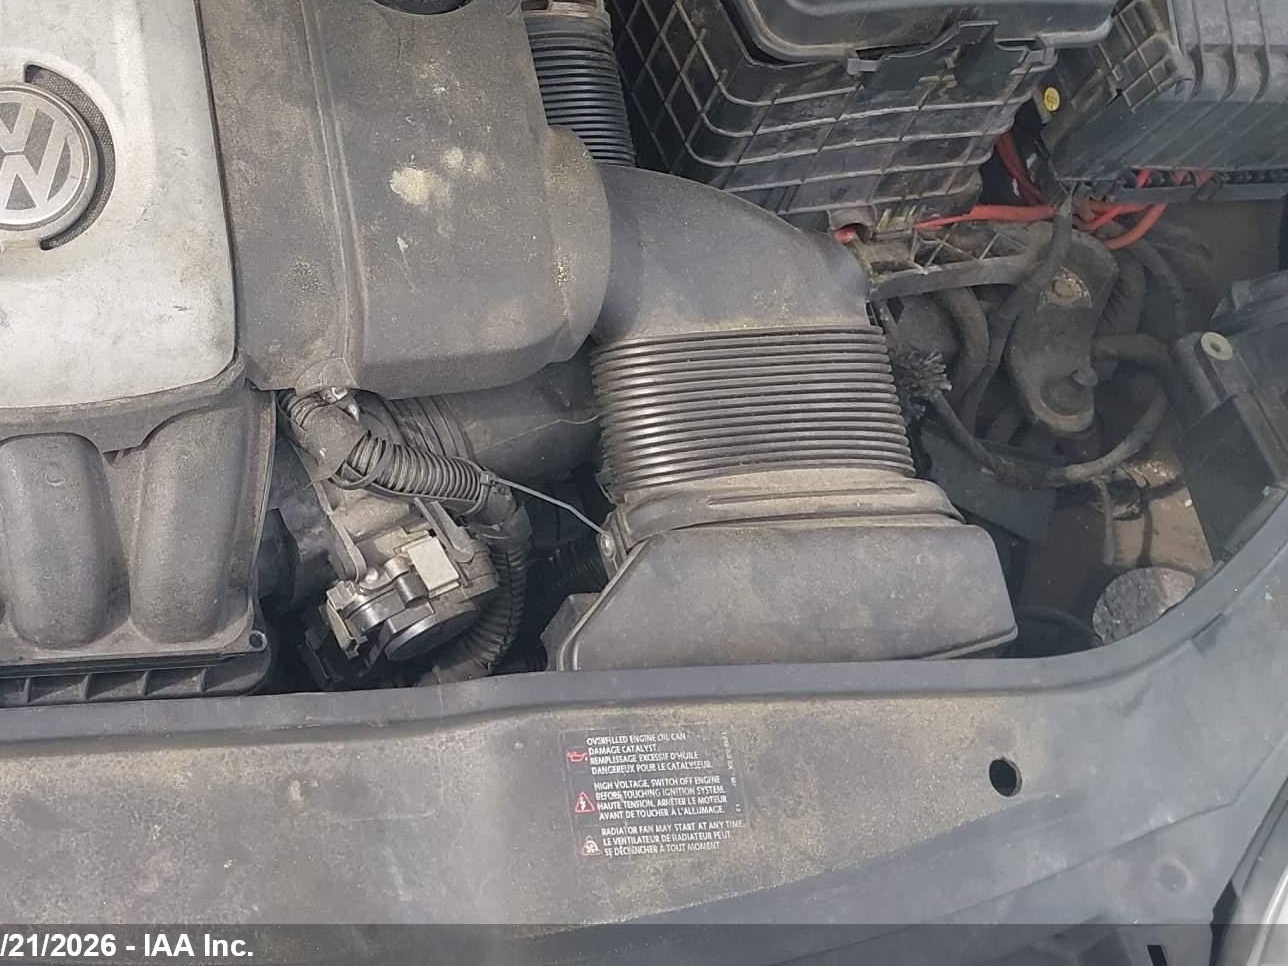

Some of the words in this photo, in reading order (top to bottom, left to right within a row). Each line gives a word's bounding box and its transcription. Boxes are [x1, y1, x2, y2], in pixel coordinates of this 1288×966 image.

[586, 735, 629, 746] OVERFILLED
[629, 734, 656, 744] ENGINE
[657, 733, 670, 742] OIL
[670, 732, 686, 741] CAN
[587, 745, 621, 755] DAMAGE
[590, 754, 637, 765] REMPLISSAGE
[638, 752, 669, 763] EXCESSIF
[670, 751, 699, 761] D'HUILE
[591, 763, 636, 775] DANGEREUX
[636, 762, 657, 773] POUR
[657, 762, 666, 771] LE
[593, 781, 613, 790] HIGH
[650, 777, 679, 787] SWITCH
[679, 777, 692, 786] OFF
[694, 775, 721, 785] ENGINE
[595, 791, 622, 801] BEFORE
[622, 788, 661, 800] TOUCHING
[661, 786, 696, 797] IGNITION
[597, 801, 622, 811] HAUTE
[687, 796, 697, 805] LE
[697, 795, 728, 805] MOTEUR
[599, 810, 624, 821] AVANT
[625, 810, 636, 819] DE
[636, 808, 669, 819] TOUCHER
[601, 825, 638, 836] RADIATOR
[638, 825, 654, 834] FAN
[655, 824, 672, 833] MAY
[673, 822, 696, 832] START
[698, 821, 708, 831] AT
[708, 820, 724, 830] ANY
[602, 837, 612, 846] LE
[612, 835, 660, 846] VENTILATEUR
[661, 833, 671, 843] DE
[671, 831, 712, 843] RADIATEUR
[713, 830, 731, 840] PEUT
[604, 847, 613, 857] SE
[666, 843, 686, 852] TOUT
